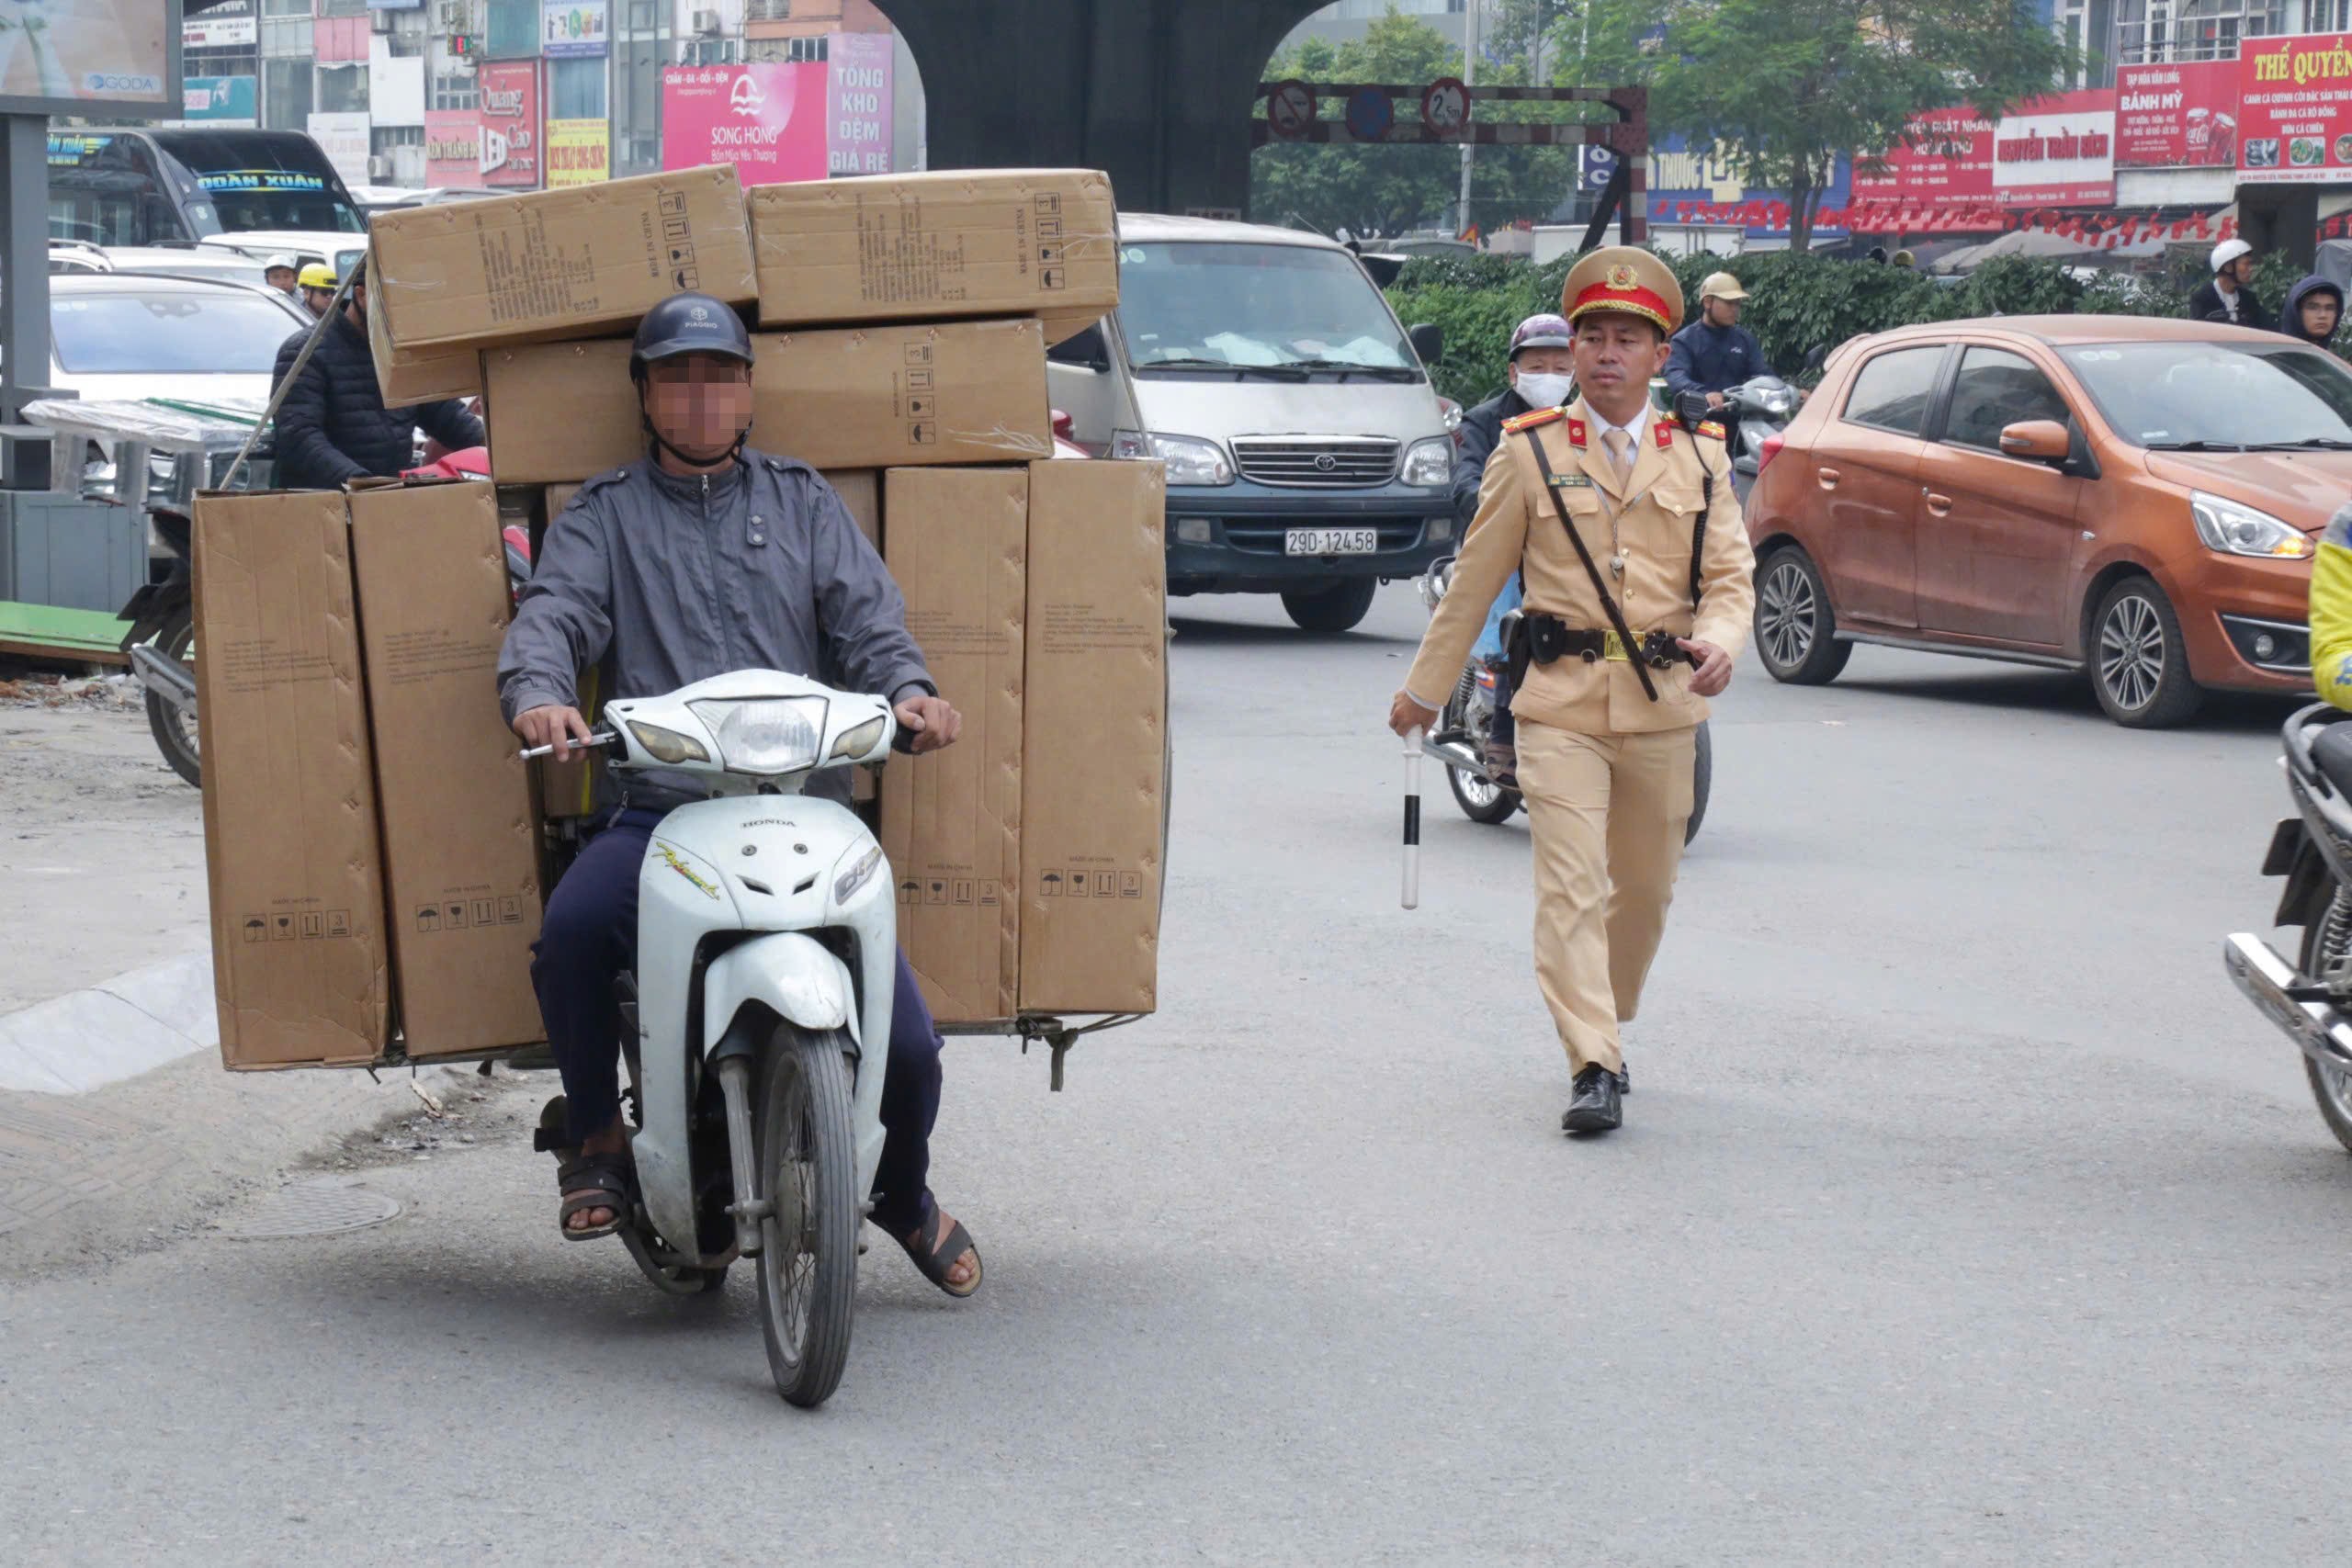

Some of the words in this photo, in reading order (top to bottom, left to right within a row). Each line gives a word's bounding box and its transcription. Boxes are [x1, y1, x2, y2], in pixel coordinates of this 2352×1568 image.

[2255, 40, 2291, 81] THẾ
[836, 59, 884, 88] TỔNG
[481, 79, 523, 118] Quảng
[842, 93, 878, 113] KHO
[2121, 91, 2160, 110] BÁNH
[2162, 89, 2183, 108] MỲ
[840, 118, 880, 144] ĐỆM
[1962, 118, 1995, 132] NHAN
[711, 126, 741, 145] SONG
[744, 126, 777, 145] HONG
[830, 148, 860, 171] GIÁ
[865, 146, 889, 172] RẺ
[265, 174, 323, 189] XUÂN
[1289, 532, 1374, 552] 29D-124.58
[741, 818, 797, 828] HONDA
